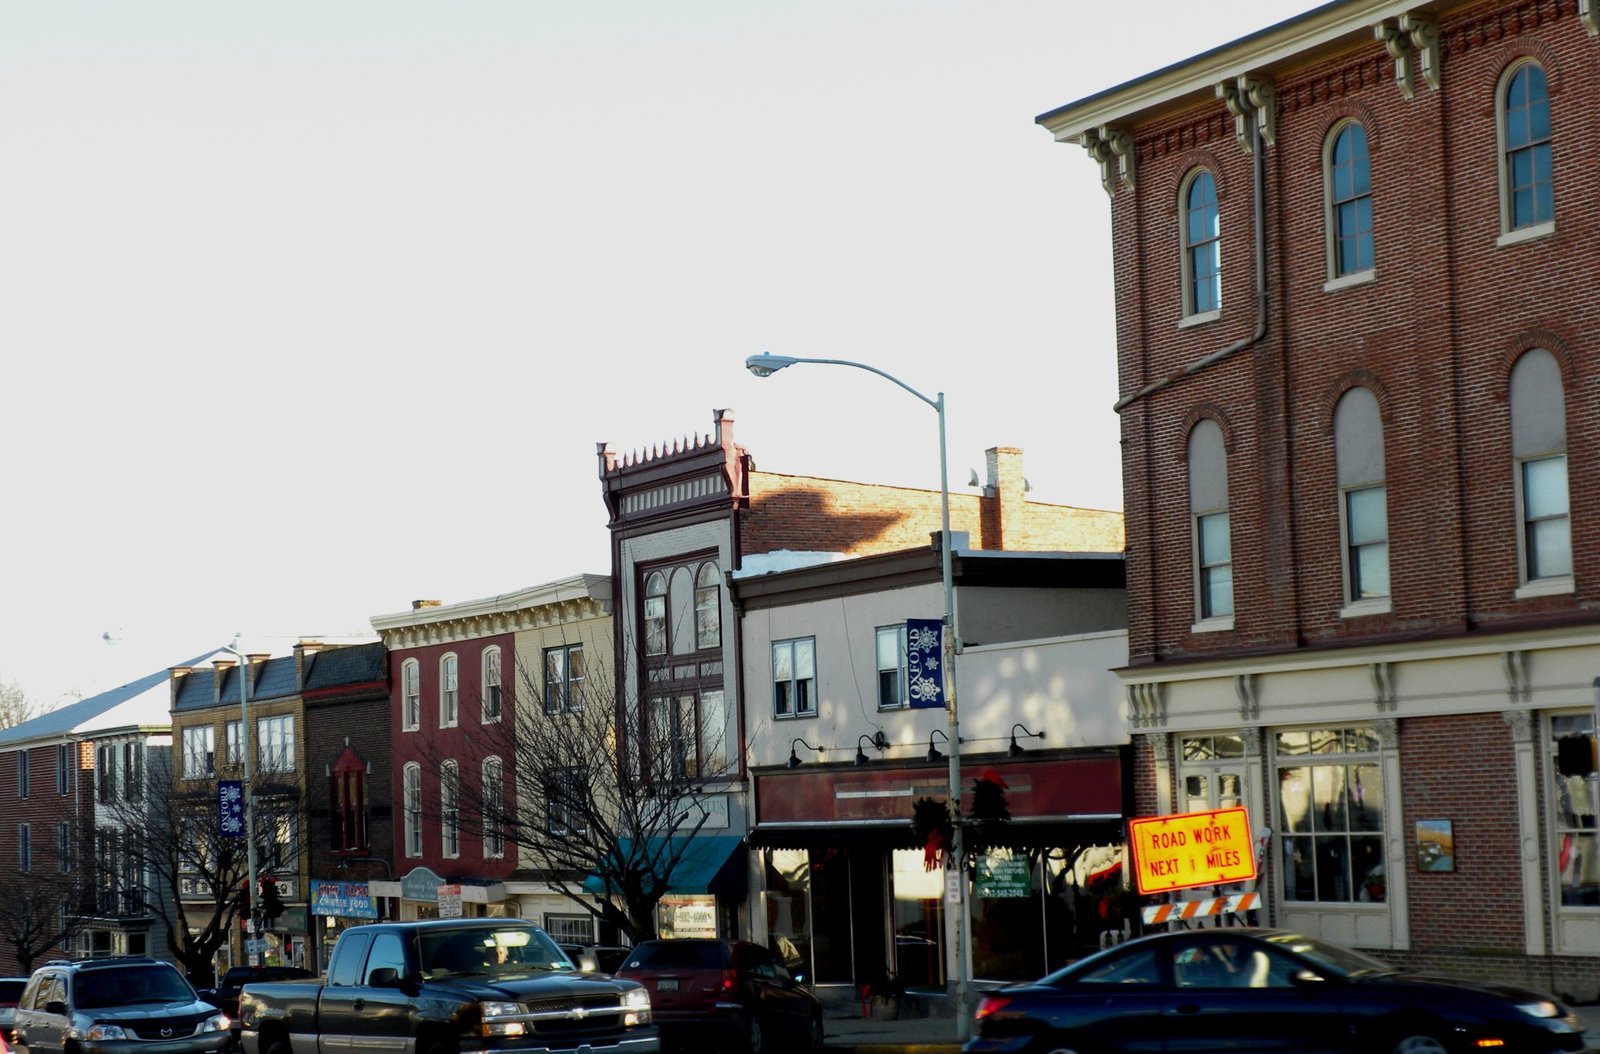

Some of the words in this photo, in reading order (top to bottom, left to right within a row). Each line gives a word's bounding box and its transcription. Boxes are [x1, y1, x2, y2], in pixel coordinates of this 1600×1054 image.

[909, 628, 922, 699] OXFORD
[220, 787, 230, 831] OXFORD
[701, 800, 725, 814] PLUS
[1152, 831, 1186, 849] ROAD
[1193, 825, 1231, 844] WORK
[1150, 858, 1179, 877] NEXT
[1191, 859, 1196, 871] 1
[1206, 851, 1241, 869] MILES
[320, 896, 347, 907] CHINESE
[350, 899, 369, 909] FOOD
